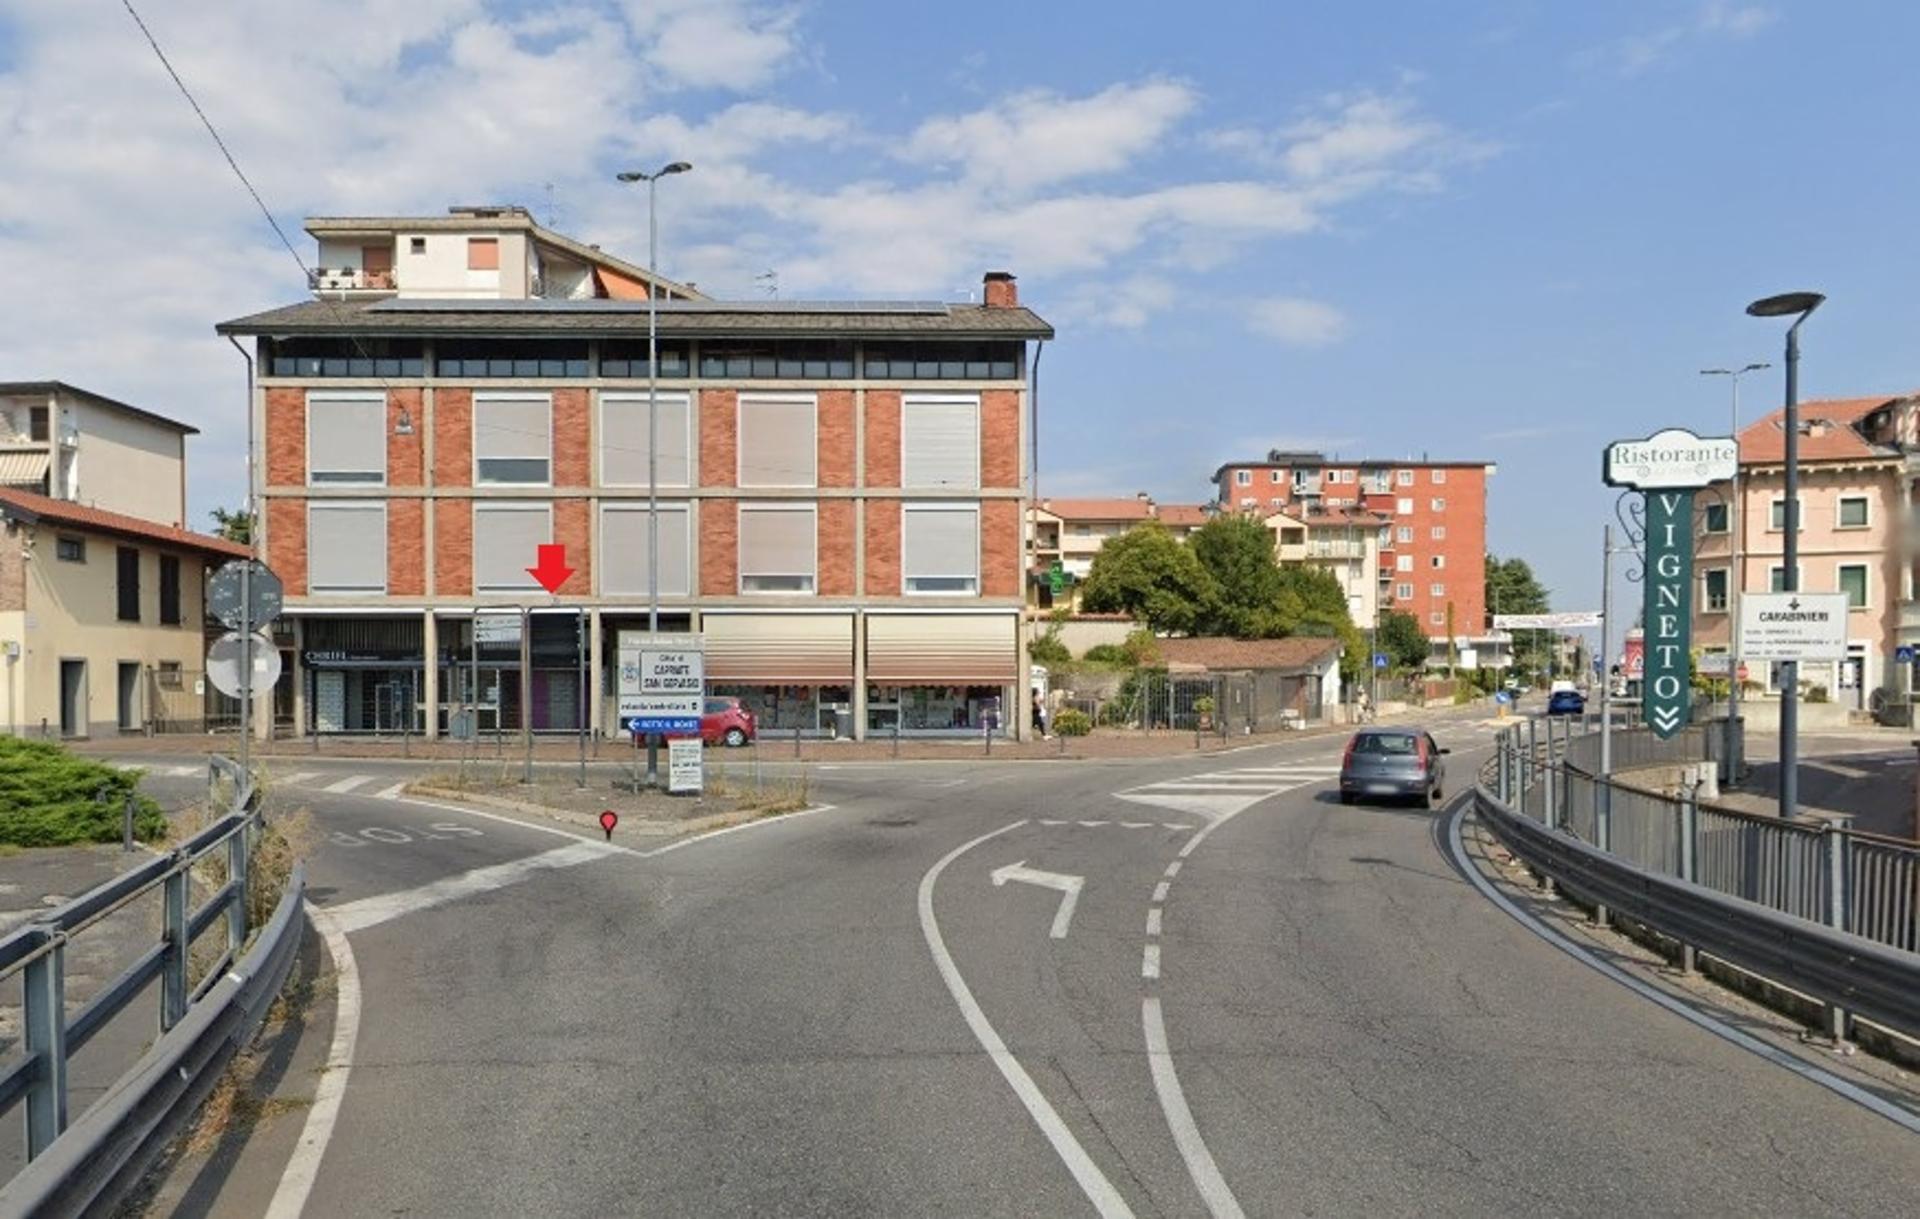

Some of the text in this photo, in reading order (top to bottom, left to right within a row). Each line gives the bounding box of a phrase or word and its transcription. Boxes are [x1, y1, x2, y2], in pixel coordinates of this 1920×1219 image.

[1615, 446, 1734, 464] Ristorante
[1654, 494, 1682, 699] VIGNETO
[1759, 612, 1829, 622] CARABINIERI
